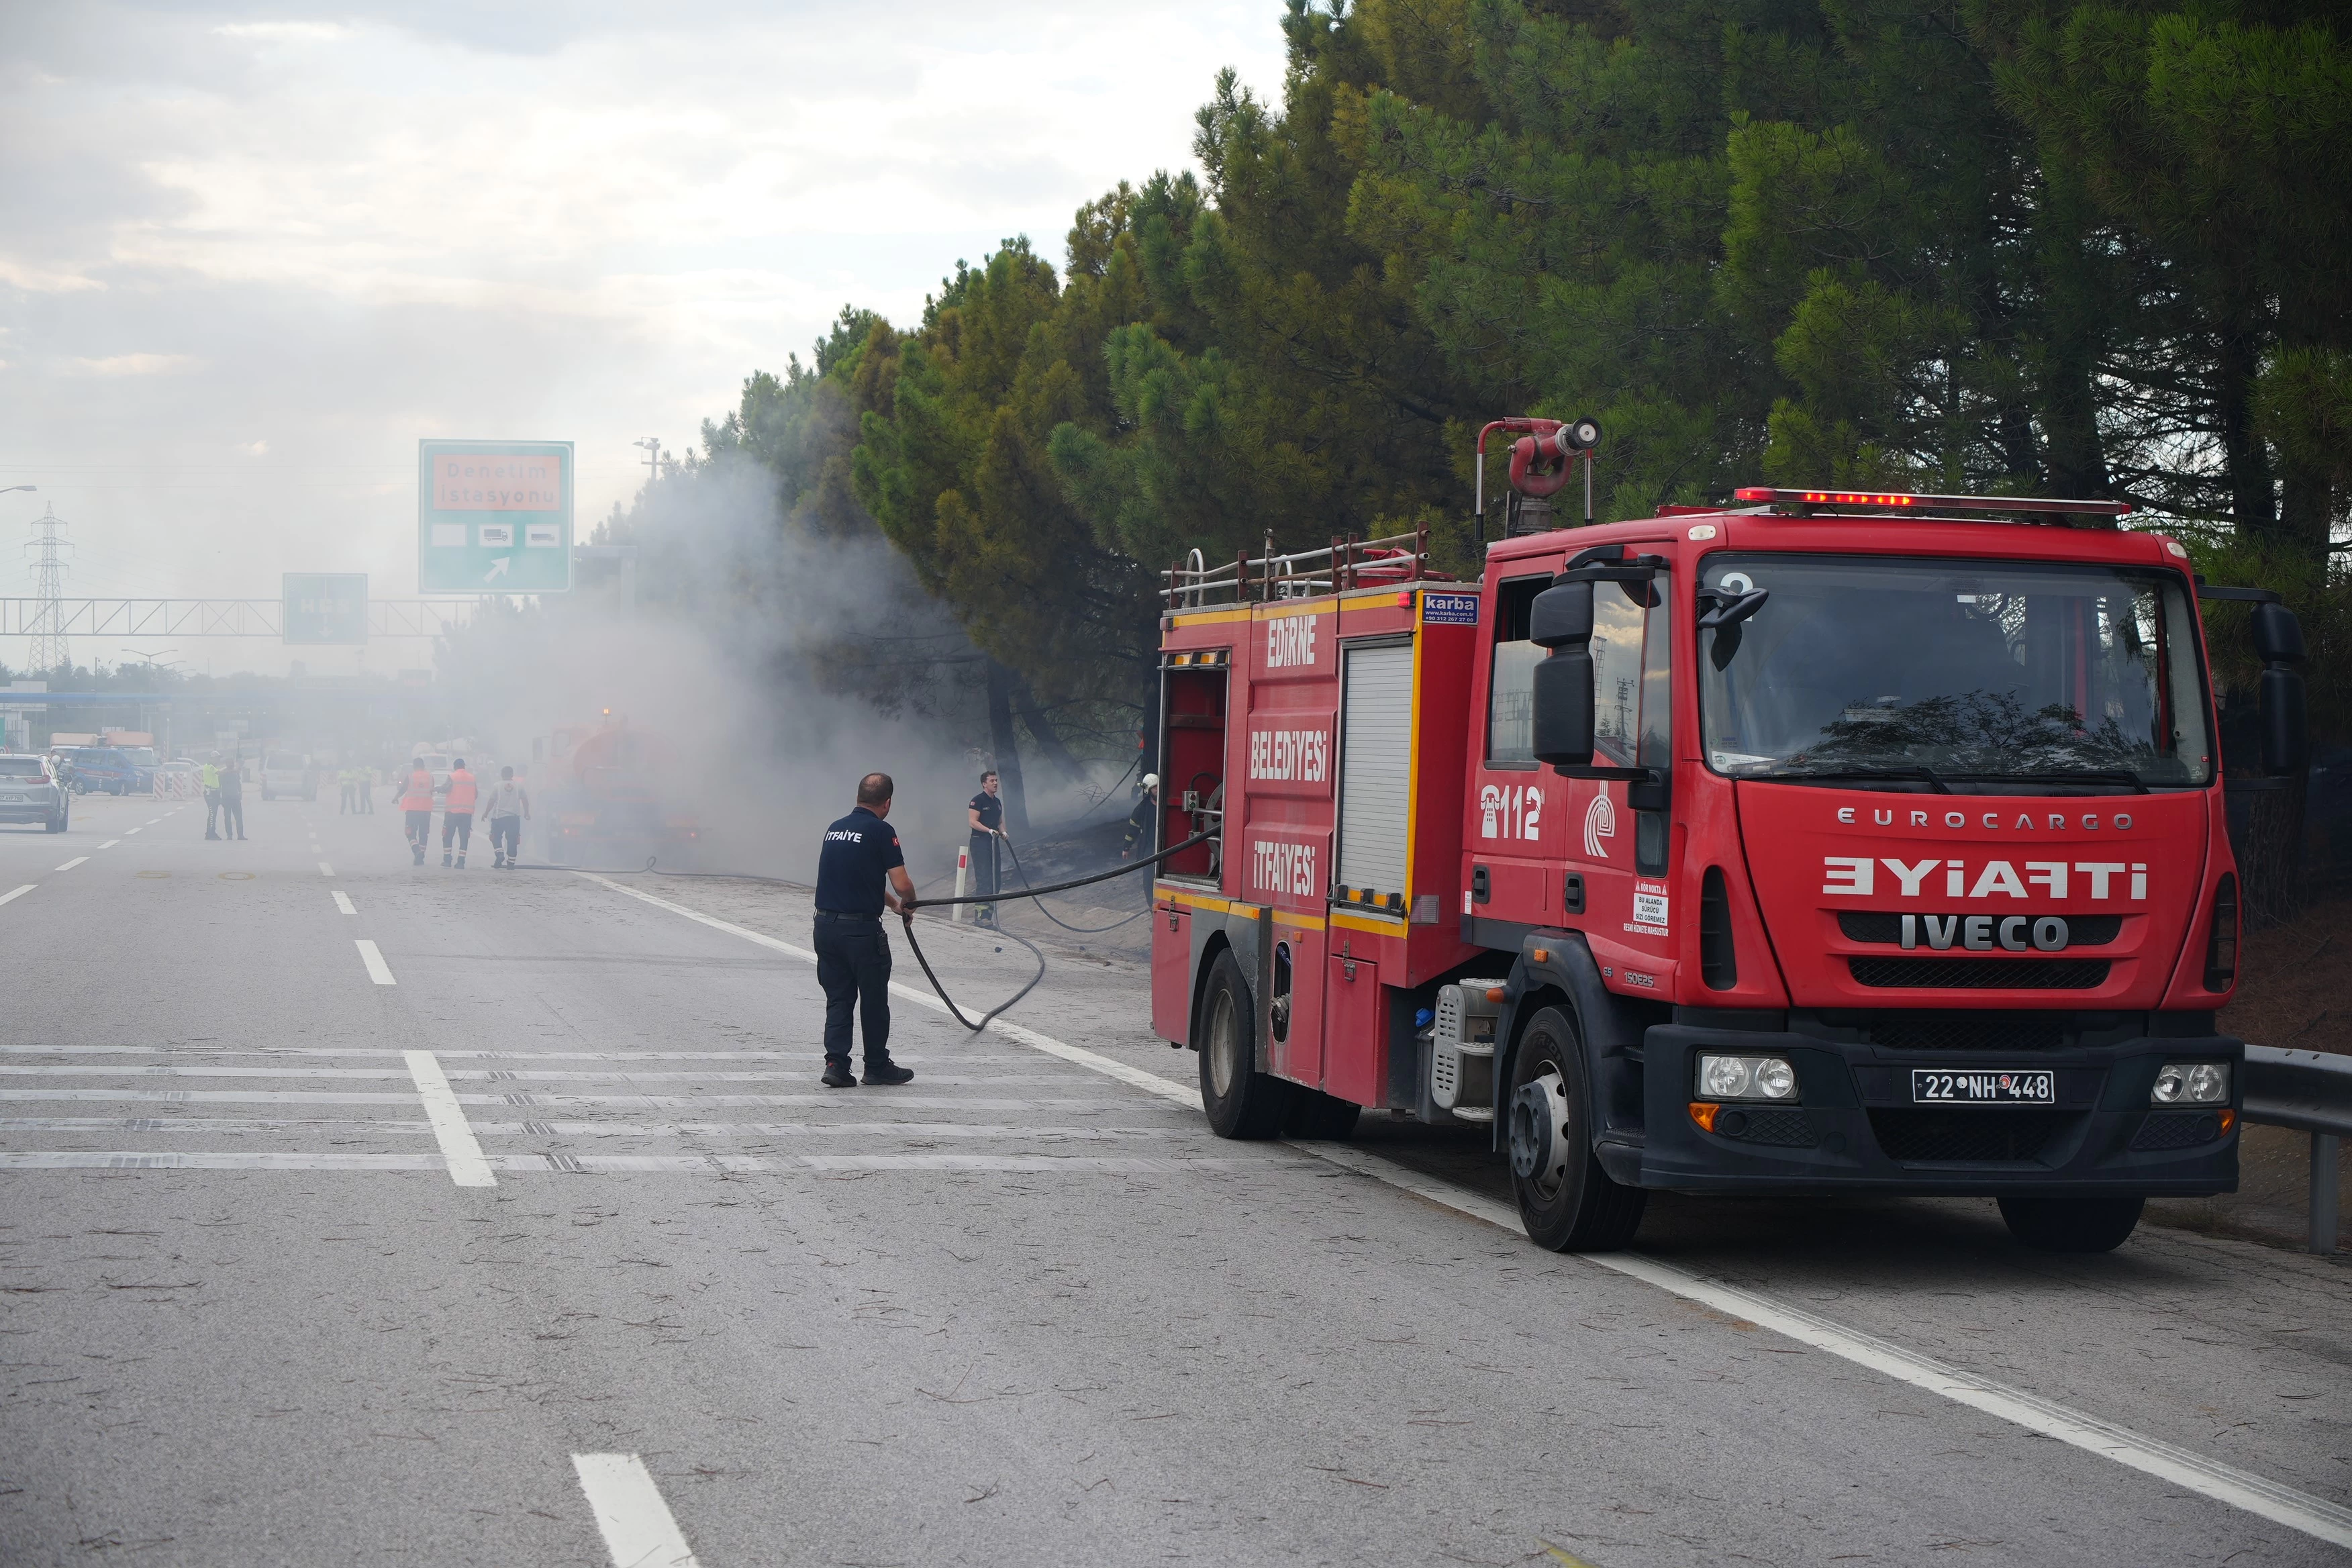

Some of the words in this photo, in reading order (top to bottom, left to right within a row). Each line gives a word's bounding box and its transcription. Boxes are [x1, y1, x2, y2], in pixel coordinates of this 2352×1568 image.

[447, 462, 546, 479] Denetim
[441, 484, 554, 506] İstasyonu
[1426, 596, 1474, 610] karba
[1500, 785, 1542, 841] 112
[1837, 807, 2133, 830] EUROCARGO
[1649, 884, 1661, 895] NOKTA
[1645, 897, 1663, 905] ALANDA
[1641, 905, 1659, 914] SÜRÜCÜ
[1644, 914, 1665, 924] GÖREMEZ
[1901, 914, 2069, 952] IVECO
[1624, 971, 1654, 987] 150E25
[1926, 1075, 1954, 1098] 22
[1969, 1075, 1996, 1098] NH
[2008, 1075, 2049, 1099] 448
